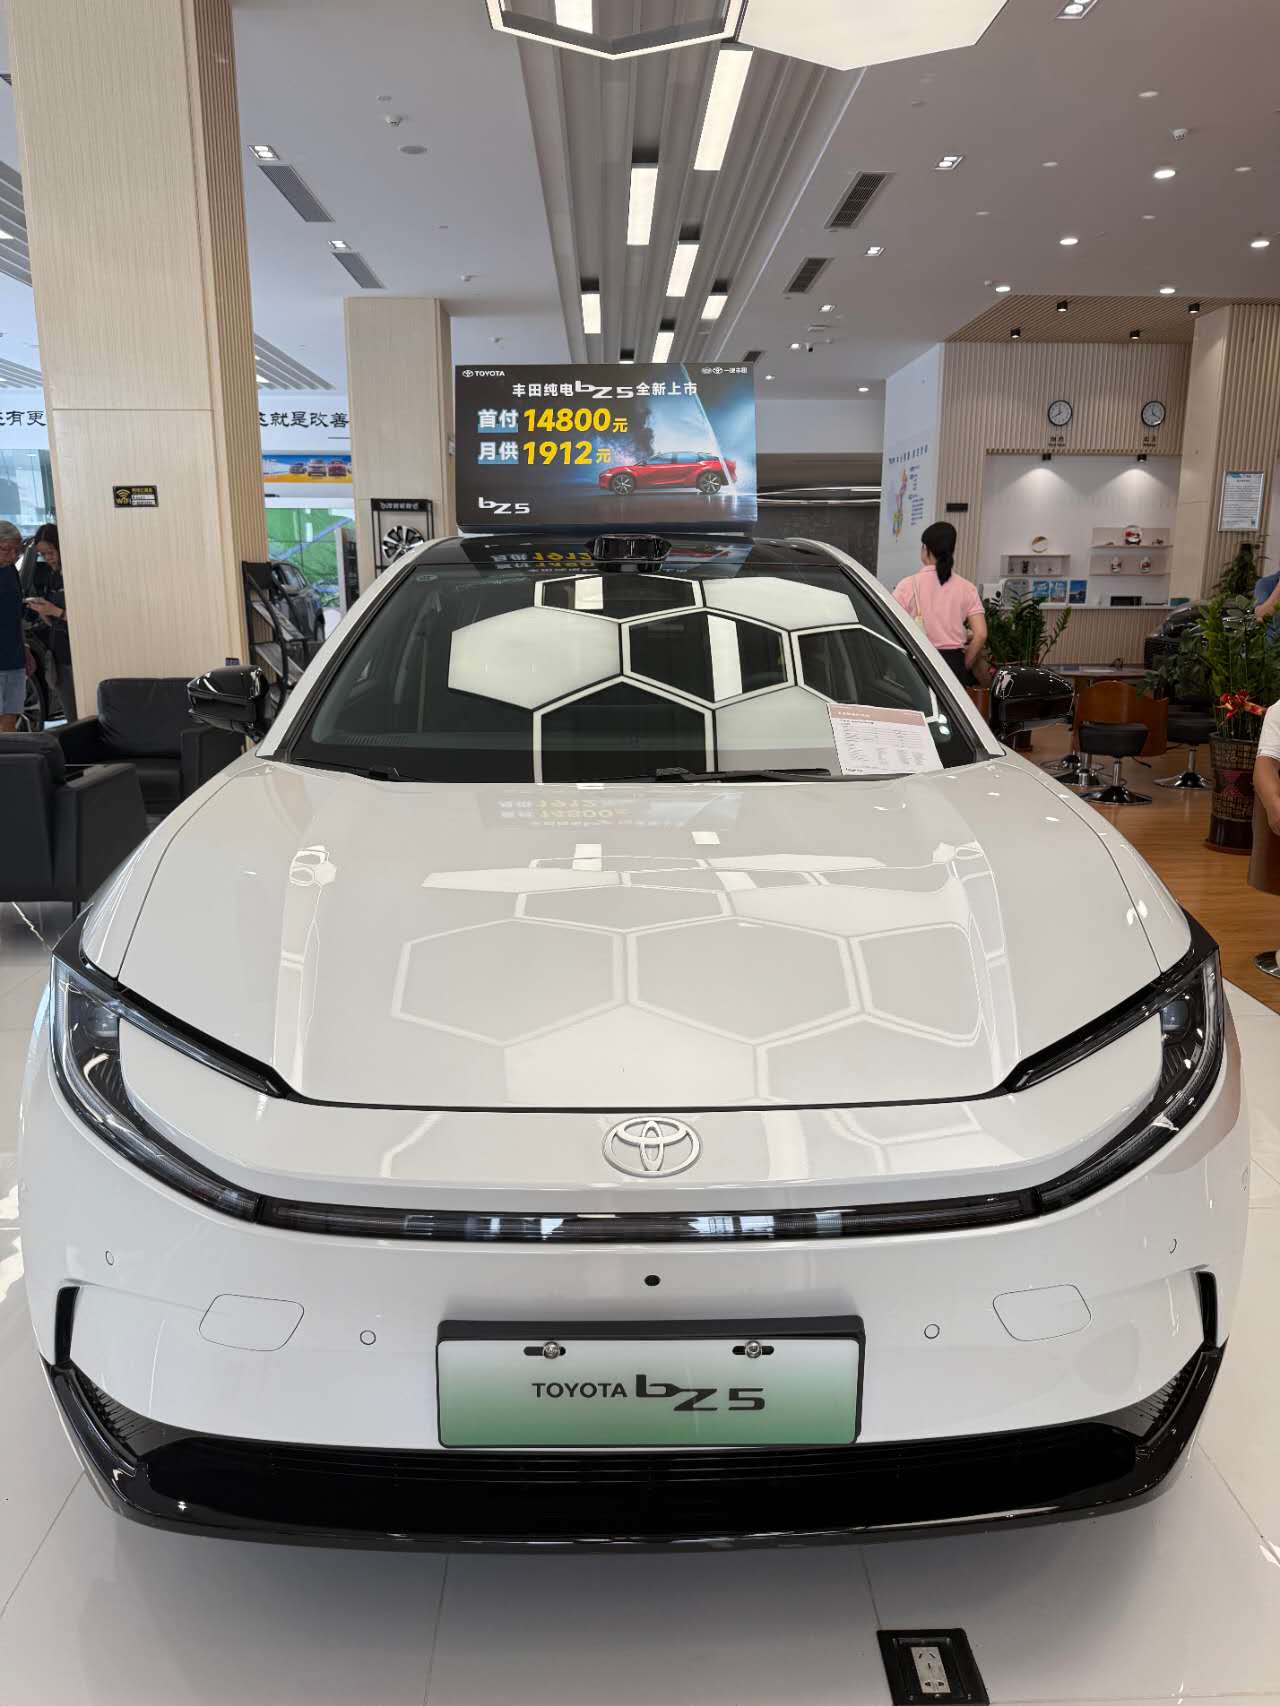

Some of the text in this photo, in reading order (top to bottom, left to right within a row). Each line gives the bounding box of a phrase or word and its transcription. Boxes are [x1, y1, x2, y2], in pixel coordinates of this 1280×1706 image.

[474, 370, 506, 378] TOYOTA
[478, 407, 628, 433] 首付 14800元
[478, 440, 612, 464] 月供 1912元
[532, 1382, 627, 1398] TOYOTA
